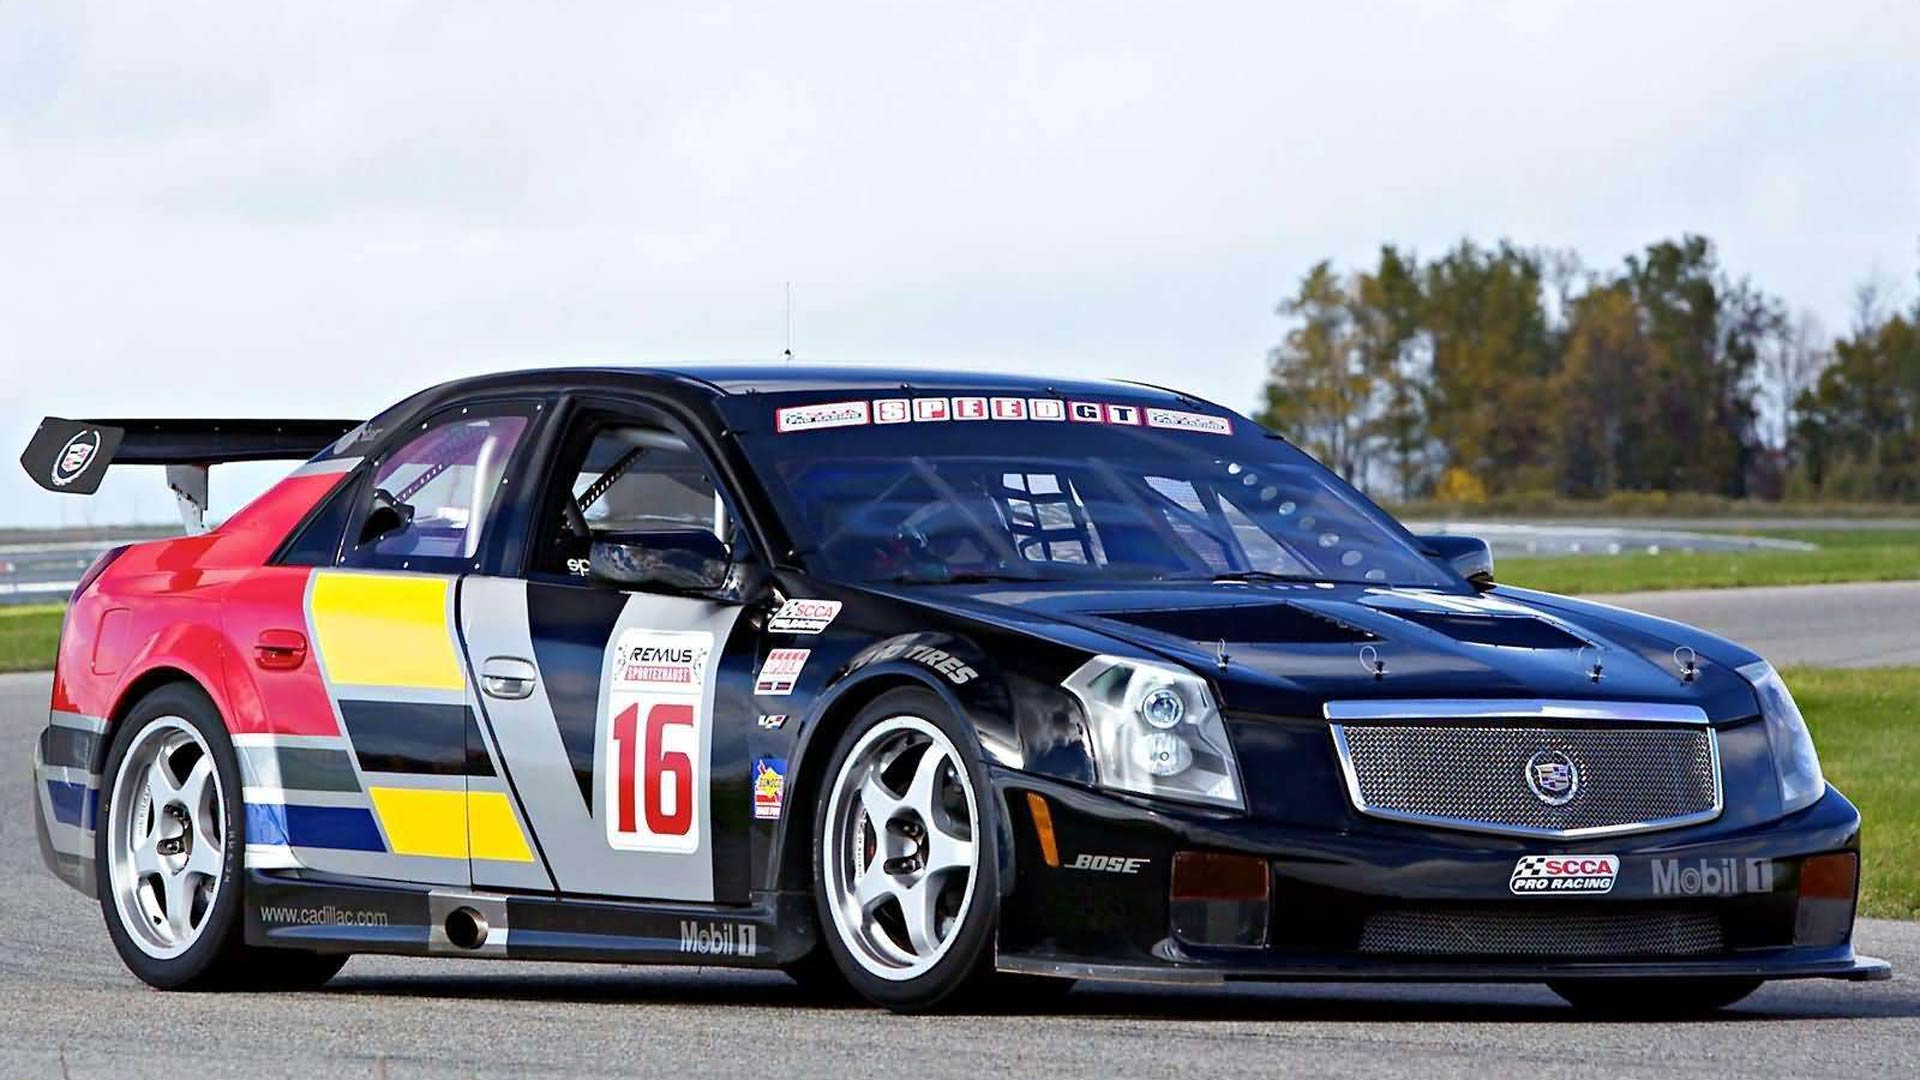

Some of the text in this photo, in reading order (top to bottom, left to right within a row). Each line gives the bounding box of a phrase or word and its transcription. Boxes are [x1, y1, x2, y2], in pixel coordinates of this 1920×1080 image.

[878, 398, 1061, 421] SPEED
[795, 604, 834, 618] SCCA
[629, 647, 692, 663] REMUS
[903, 644, 979, 685] TIRES
[613, 702, 694, 836] 16
[1064, 854, 1150, 874] BOSE
[1545, 860, 1613, 875] SCCA
[1514, 878, 1612, 889] PRO RACING
[1651, 858, 1738, 894] Mobil
[260, 904, 389, 927] www.cadillac.com
[680, 921, 734, 955] Mobil
